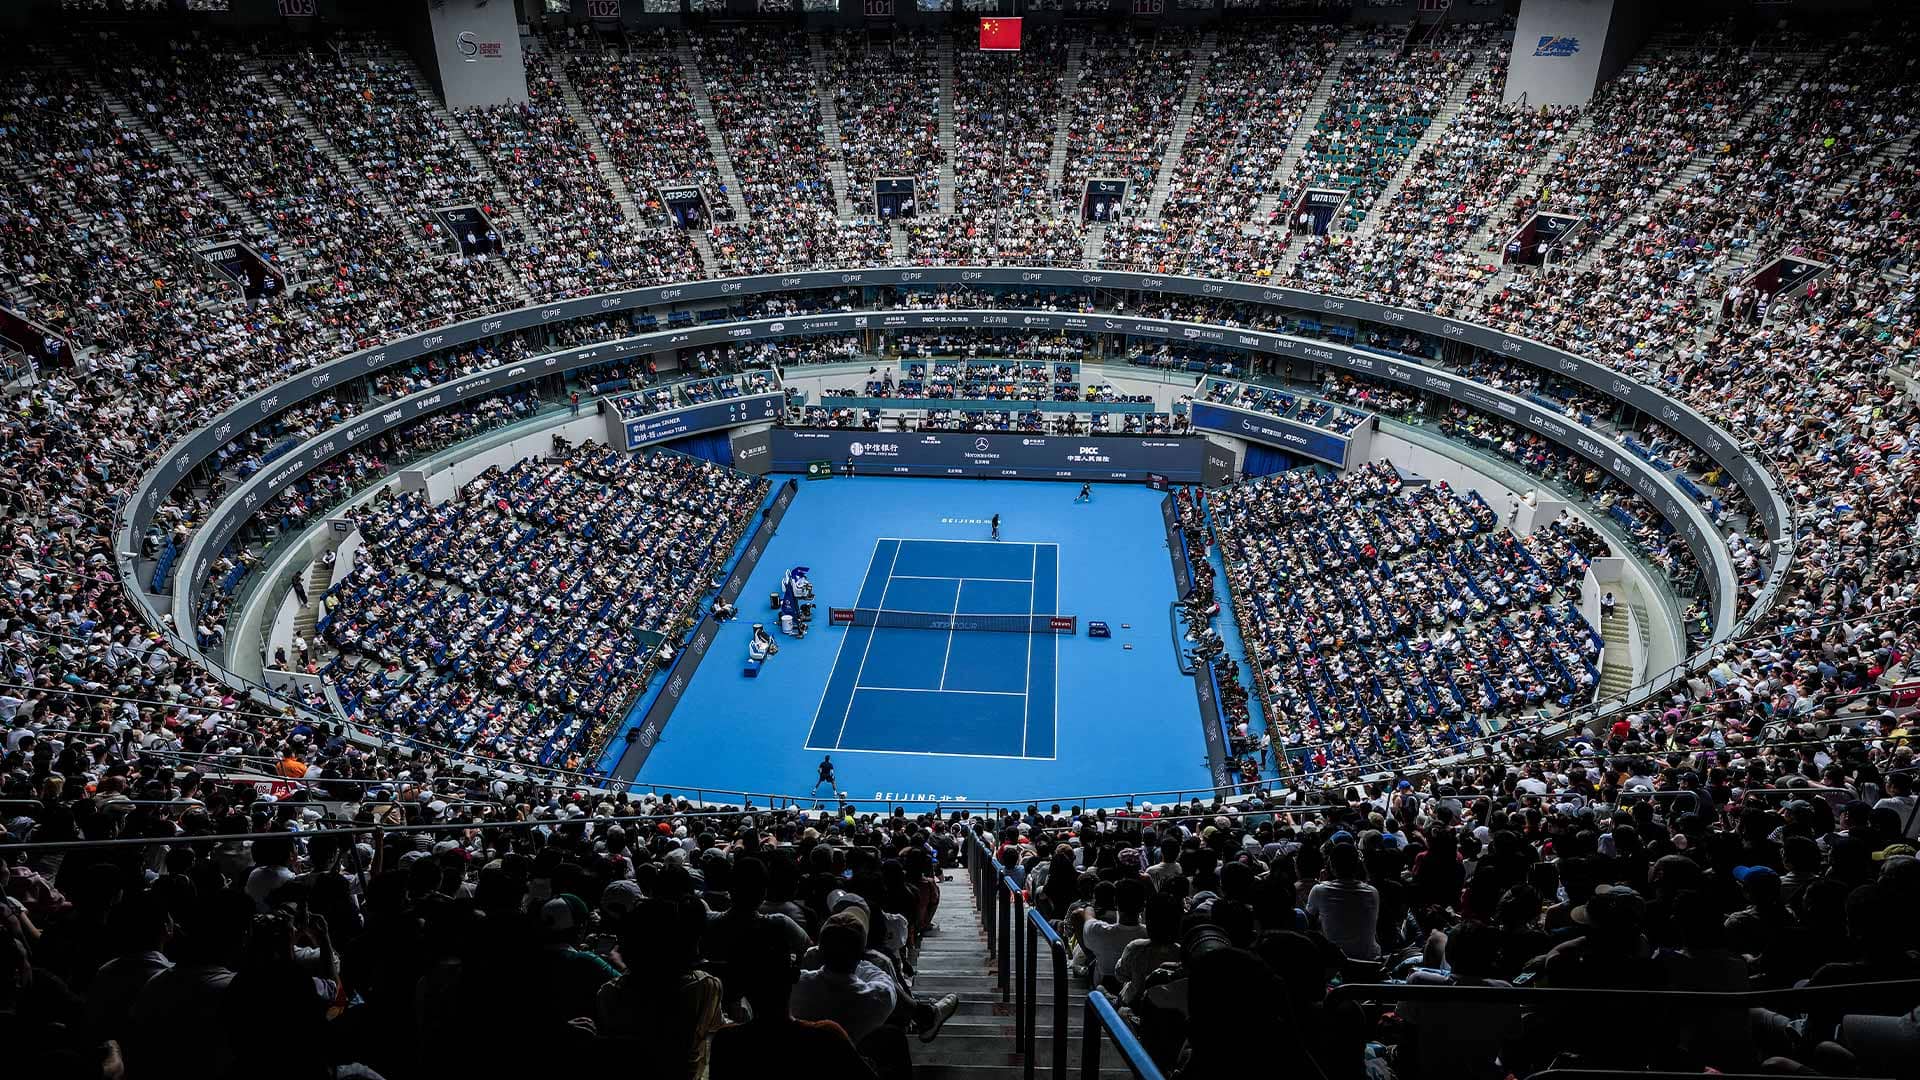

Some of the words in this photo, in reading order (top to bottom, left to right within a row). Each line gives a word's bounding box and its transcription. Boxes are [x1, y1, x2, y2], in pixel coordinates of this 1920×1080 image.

[281, 0, 313, 14] 103
[590, 2, 618, 16] 102
[867, 0, 891, 14] 101
[1136, 0, 1161, 12] 116
[911, 272, 923, 280] PIF
[971, 272, 983, 280] PIF
[1031, 273, 1042, 281] PIF
[790, 278, 802, 286] PIF
[730, 283, 742, 291] PIF
[1212, 285, 1224, 294] PIF
[670, 290, 681, 298] PIF
[1272, 293, 1285, 301] PIF
[610, 298, 622, 307] PIF
[1333, 302, 1345, 311] PIF
[550, 309, 561, 317] PIF
[1393, 313, 1405, 322] PIF
[489, 321, 502, 331] PIF
[1452, 327, 1464, 336] PIF
[431, 336, 444, 345] PIF
[1510, 343, 1523, 353] PIF
[375, 353, 386, 363] PIF
[1567, 363, 1579, 372] PIF
[319, 373, 330, 384] PIF
[1620, 384, 1632, 396] PIF
[268, 396, 278, 408] PIF
[765, 409, 774, 417] 40
[1670, 409, 1680, 422] PIF
[221, 423, 232, 436] PIF
[864, 443, 899, 452] 中信银行
[1712, 441, 1722, 452] PIF
[180, 453, 190, 467] PIF
[1067, 455, 1110, 463] 中国人民保险
[699, 633, 708, 648] PIF
[674, 675, 684, 690] PIF
[646, 721, 657, 739] PIF
[875, 792, 937, 801] BEIJING
